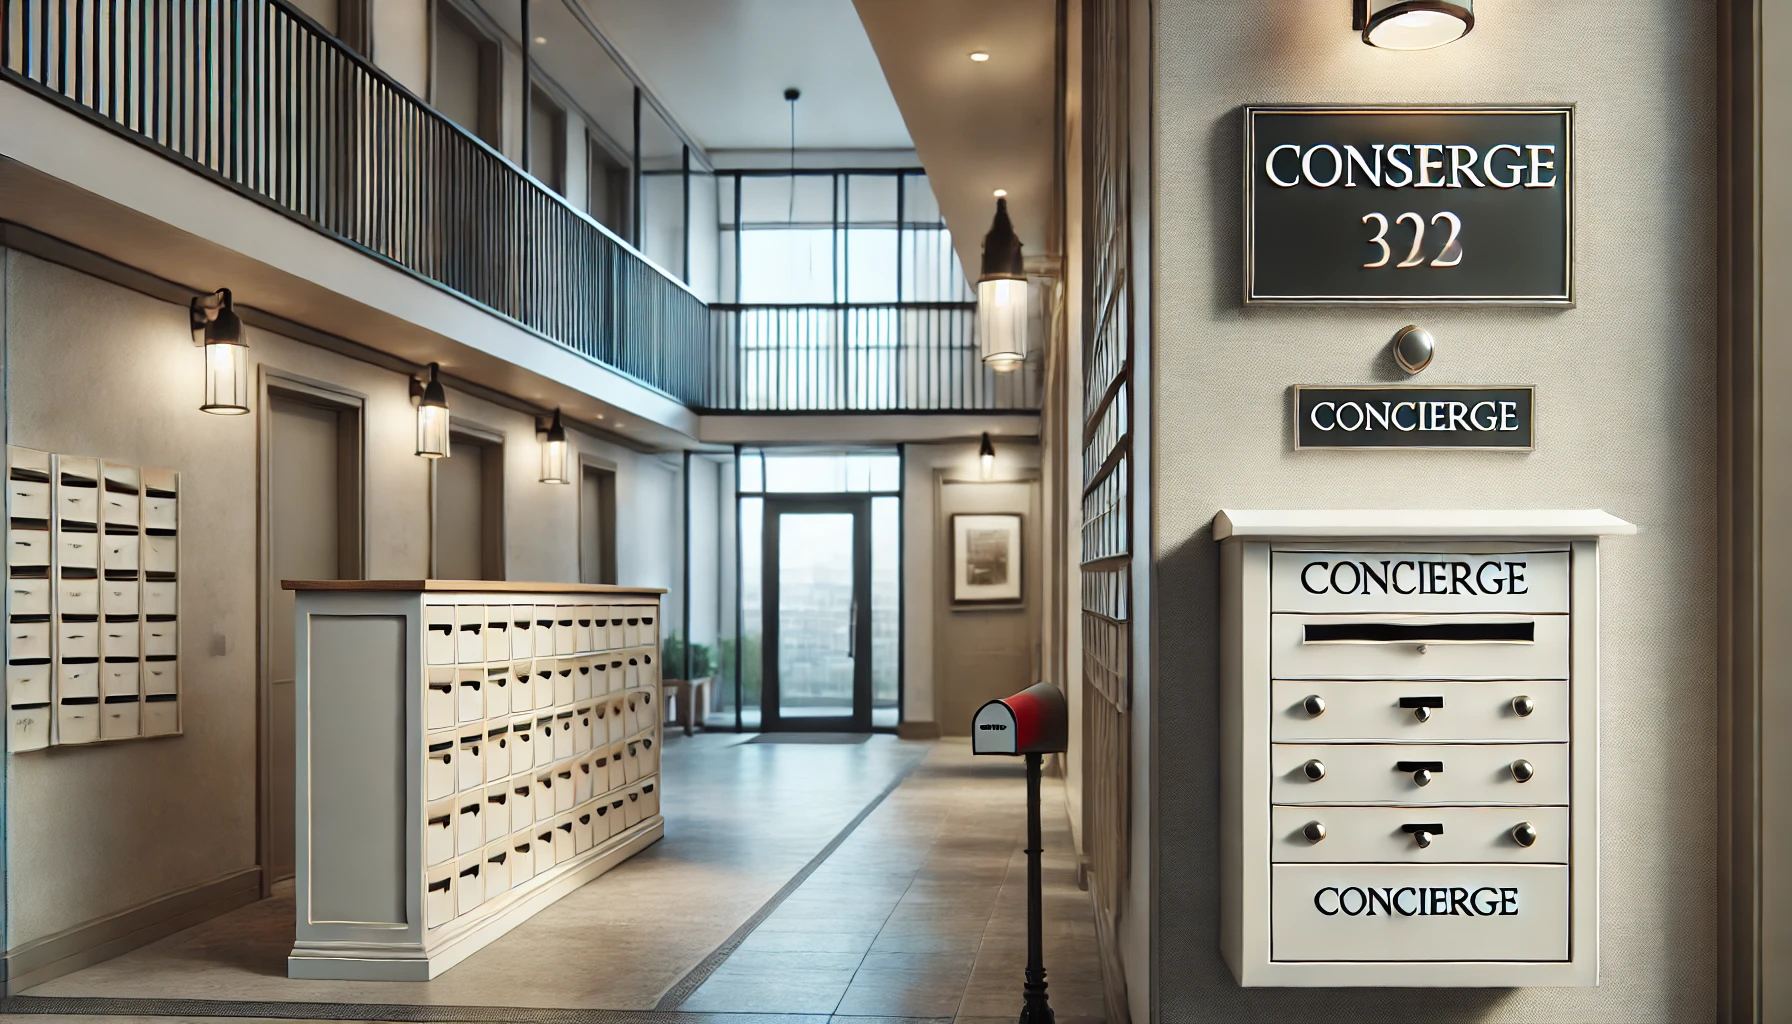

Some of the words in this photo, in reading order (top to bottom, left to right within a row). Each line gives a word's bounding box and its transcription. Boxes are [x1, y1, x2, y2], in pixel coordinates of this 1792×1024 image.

[1265, 143, 1557, 188] CONSERGE
[1361, 211, 1463, 268] 322
[1310, 401, 1519, 431] CONCIERGE
[1300, 561, 1528, 595] CONCIERGE
[1313, 887, 1518, 916] CONCIERGE
